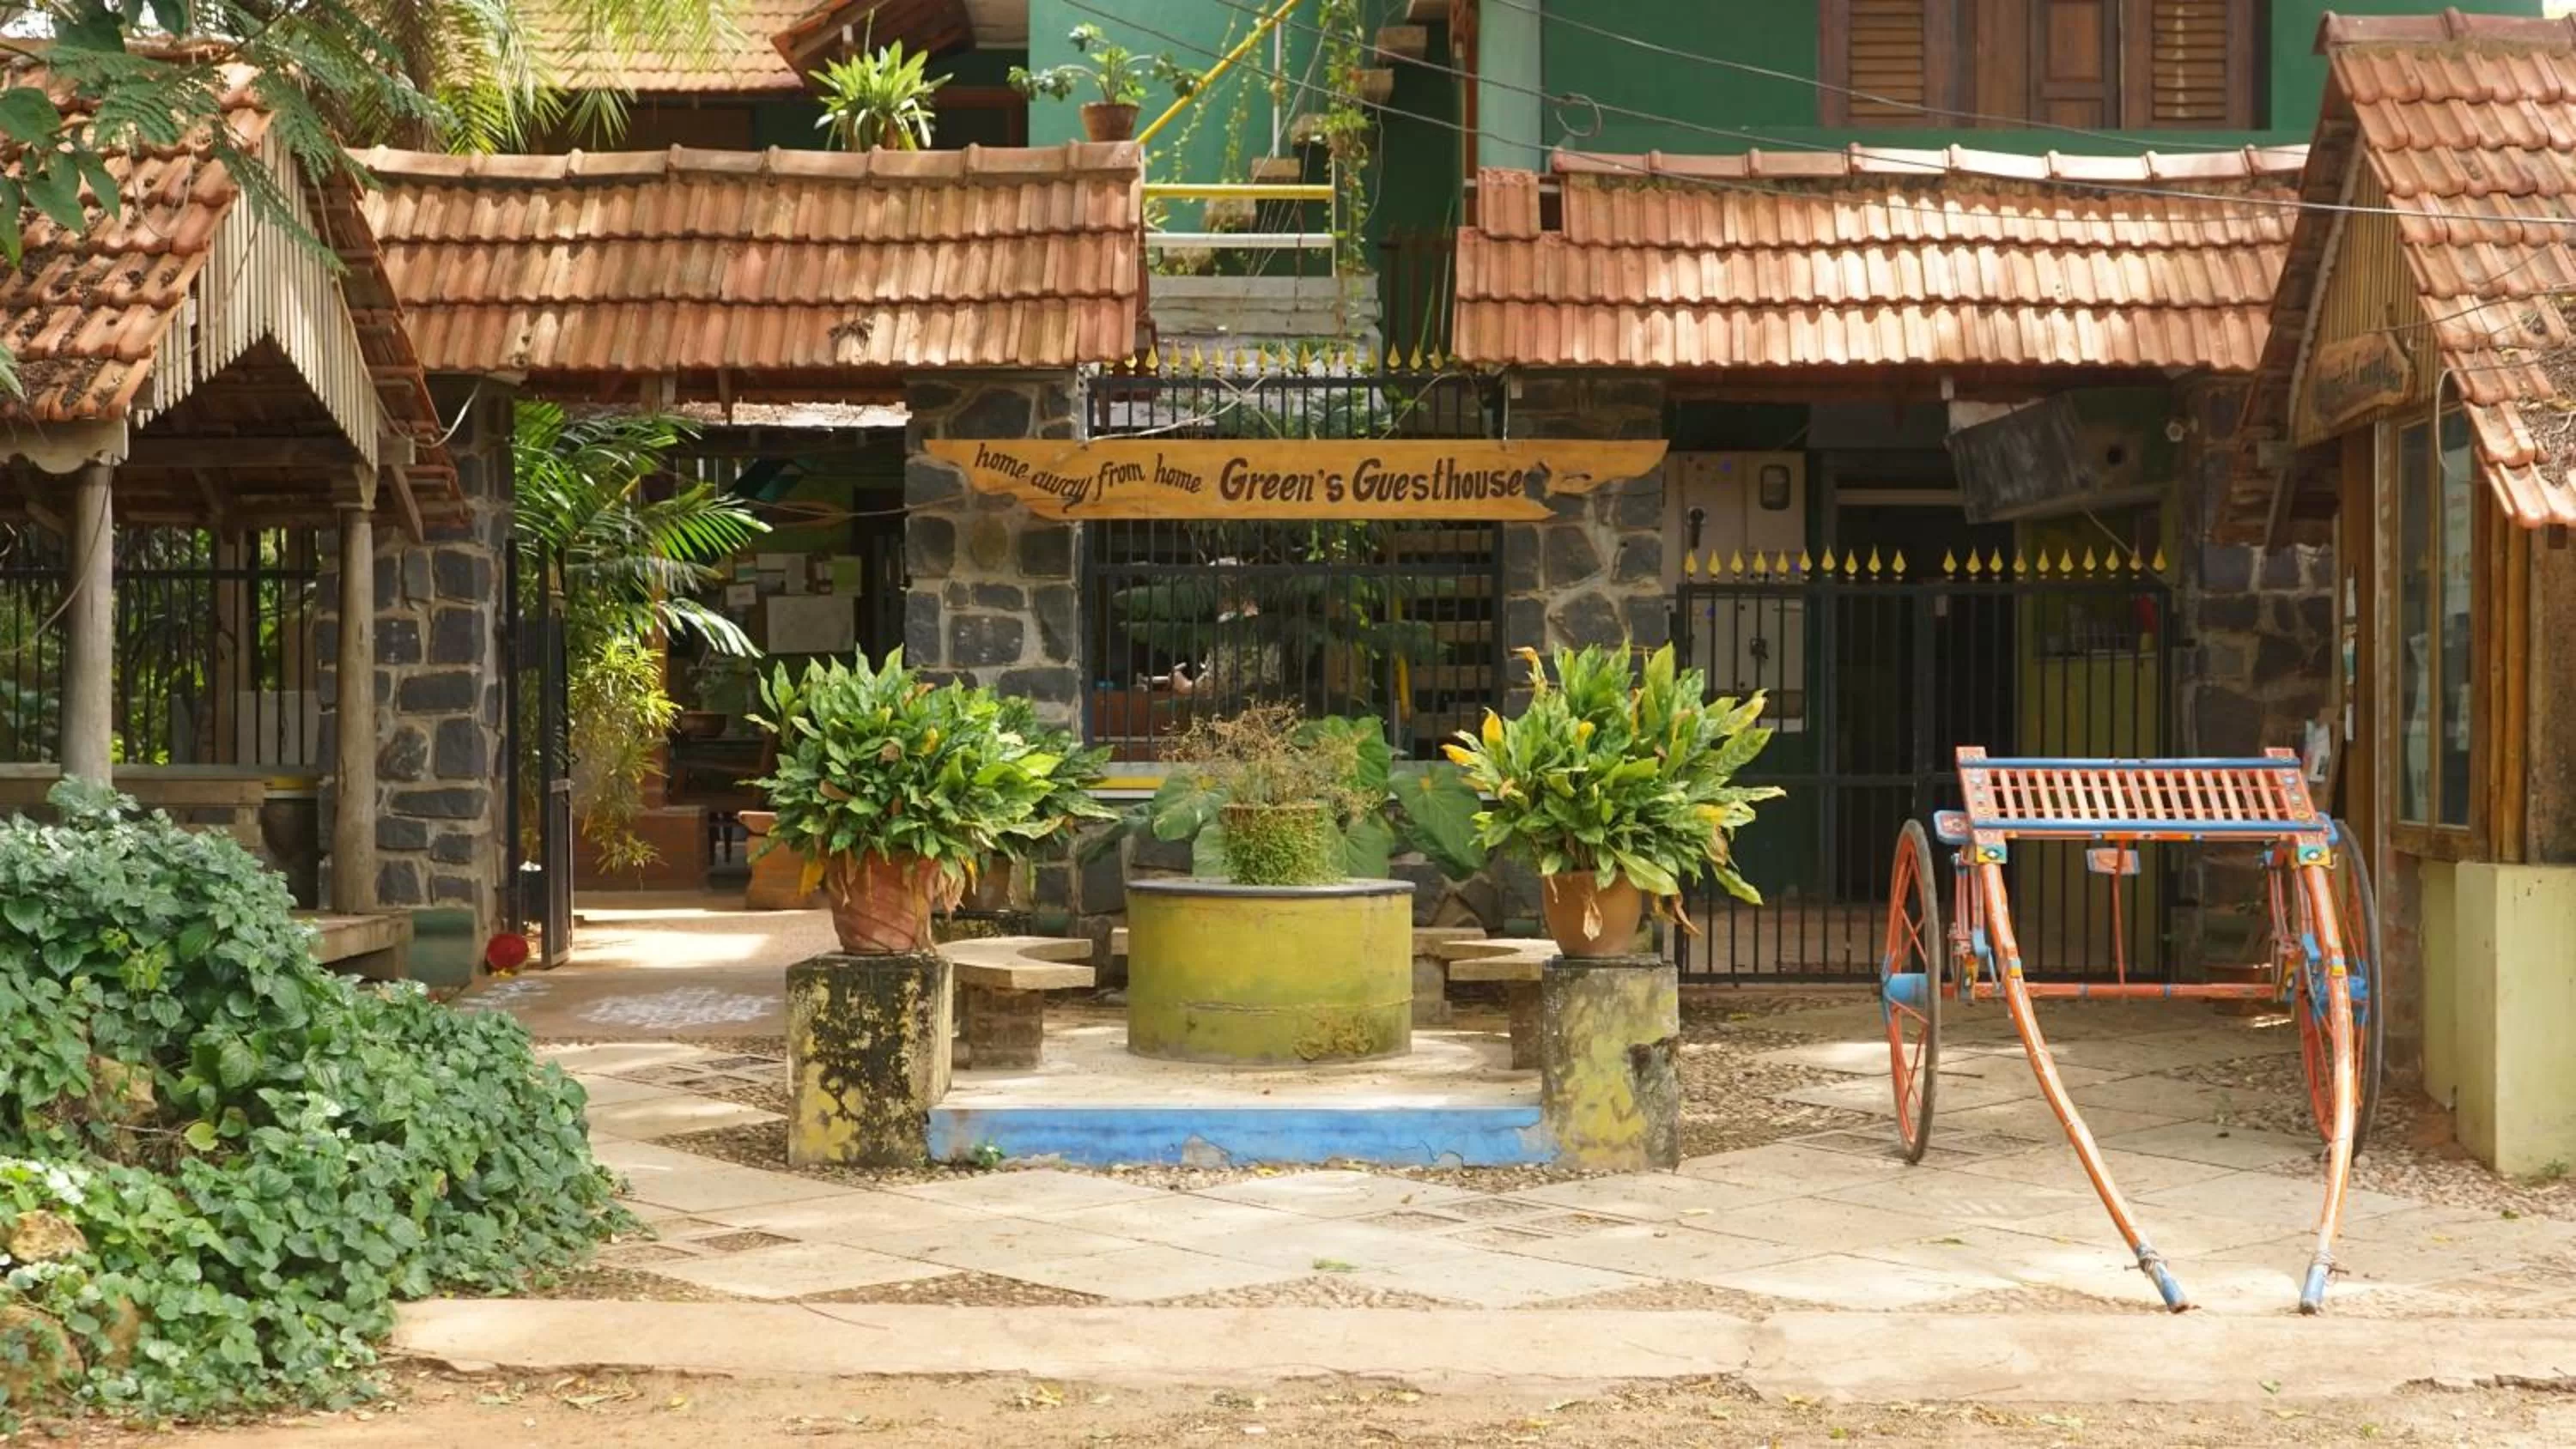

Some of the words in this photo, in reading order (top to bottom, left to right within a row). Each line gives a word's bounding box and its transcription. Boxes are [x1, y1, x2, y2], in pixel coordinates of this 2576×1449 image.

[975, 442, 1030, 477] home
[1030, 470, 1093, 513] away
[1095, 461, 1145, 501] from
[1153, 452, 1202, 494] home
[1219, 458, 1345, 502] Green's
[1352, 457, 1522, 502] Guesthouse
